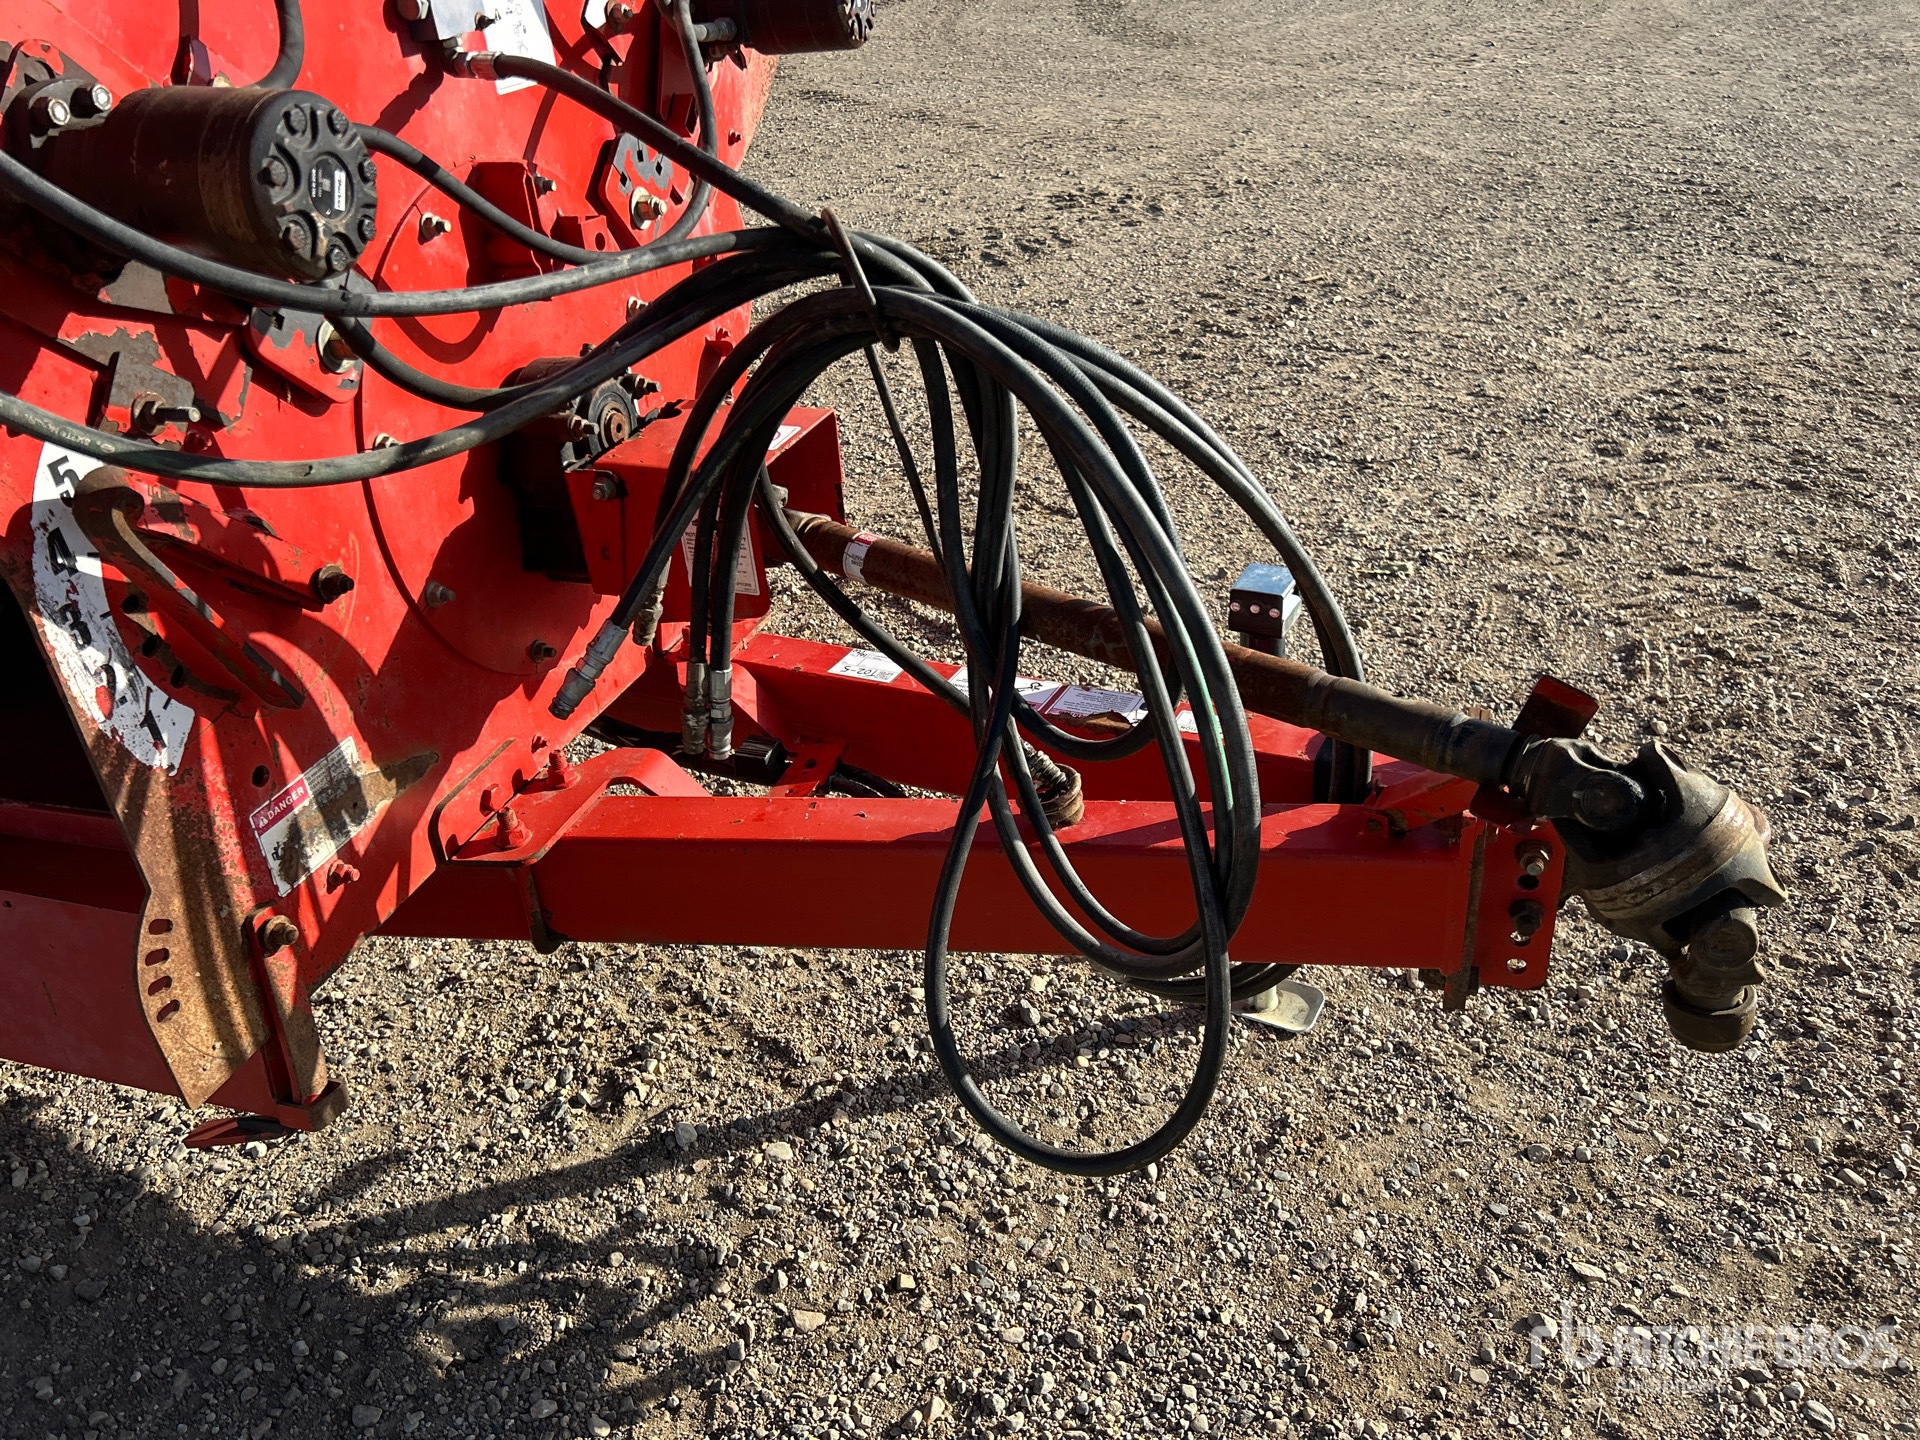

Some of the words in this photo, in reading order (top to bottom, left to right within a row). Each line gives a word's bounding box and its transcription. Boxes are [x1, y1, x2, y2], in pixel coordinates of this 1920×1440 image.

[47, 455, 80, 508] 5
[47, 527, 79, 576] 4
[57, 602, 92, 649] 3
[139, 709, 168, 750] 1
[267, 786, 305, 821] DANGER
